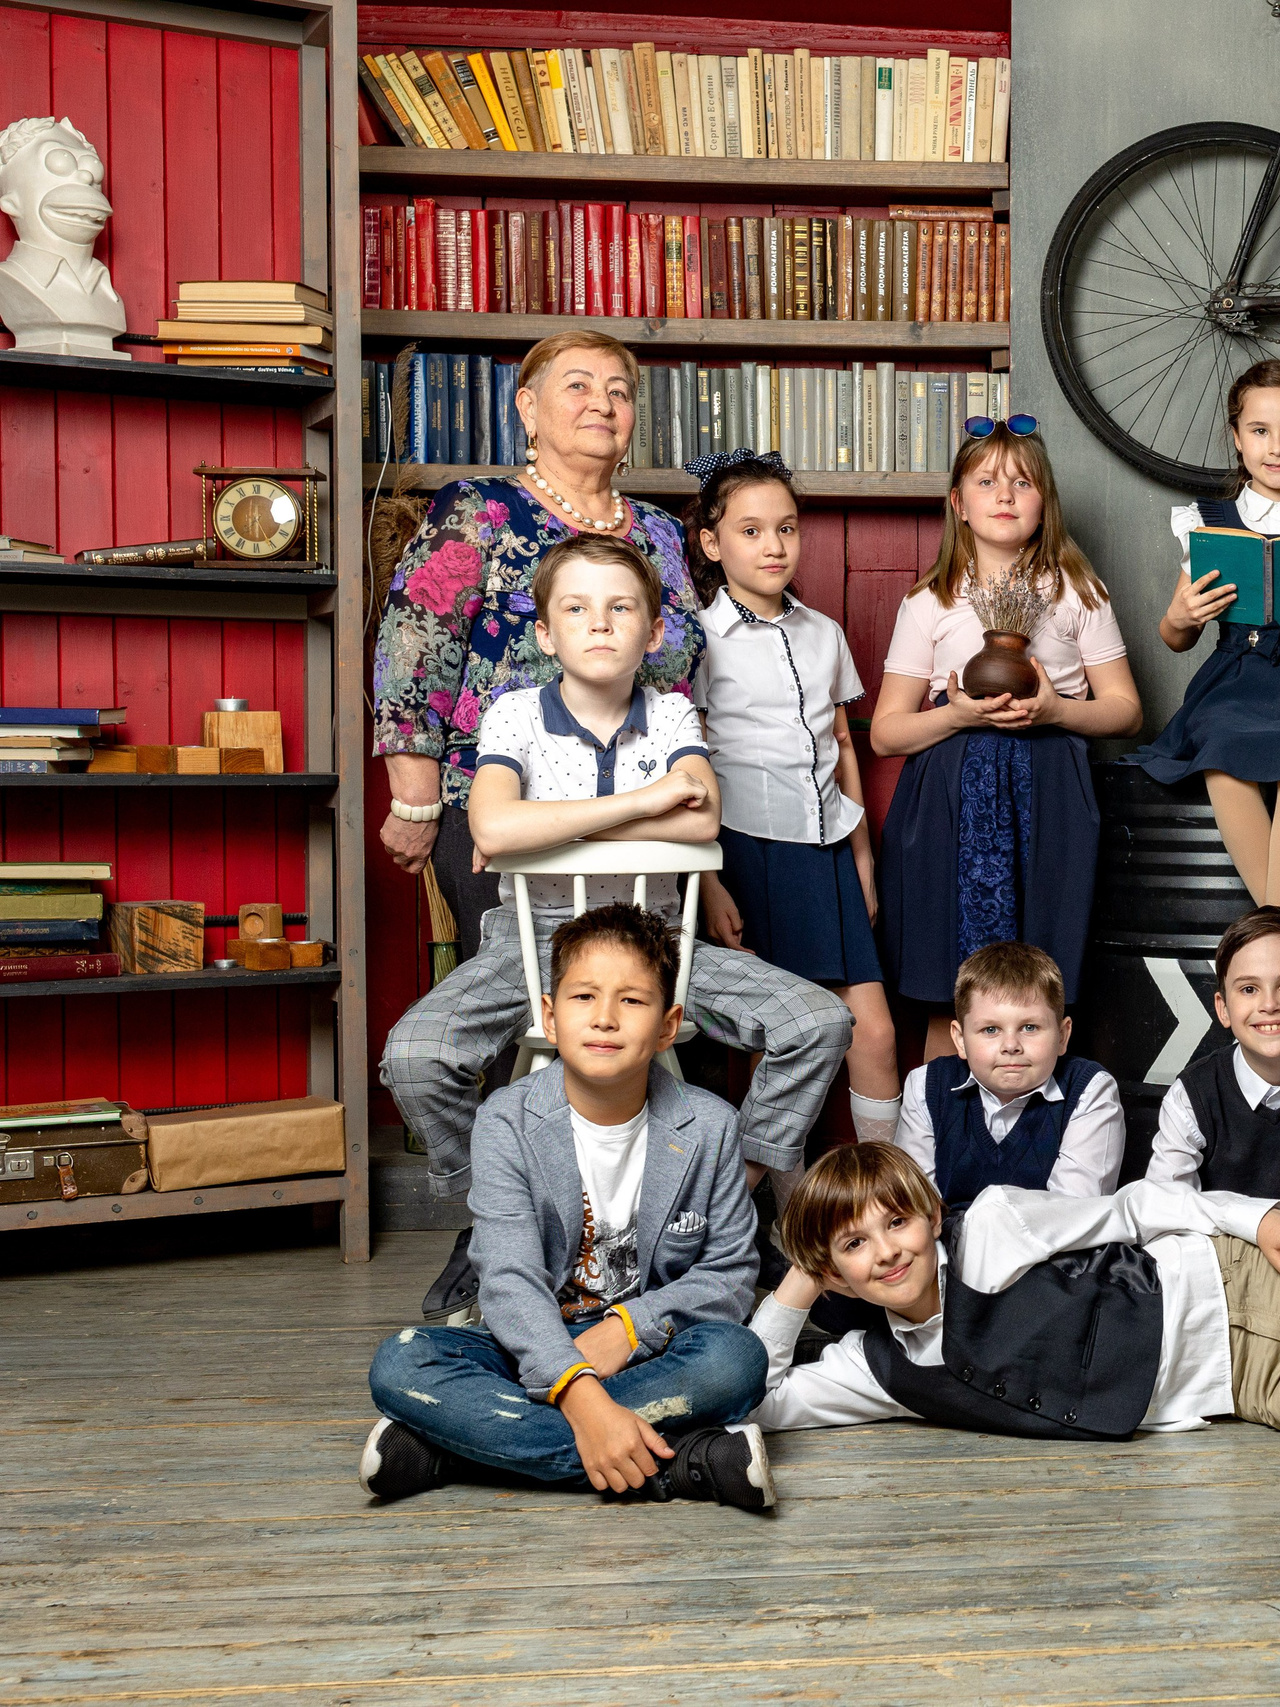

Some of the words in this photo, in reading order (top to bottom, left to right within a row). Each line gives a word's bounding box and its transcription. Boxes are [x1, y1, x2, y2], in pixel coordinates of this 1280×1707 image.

[499, 67, 516, 99] ГРИН
[967, 68, 975, 102] ТУННЕЛЬ
[707, 75, 715, 112] Есенин
[511, 105, 527, 139] ГРЭМ
[681, 107, 689, 127] МАКС
[708, 116, 719, 151] Сергей
[785, 131, 793, 156] БОРИС
[592, 230, 600, 283] ЛЕКАРСТВЕННЫЕ
[628, 235, 639, 279] НАБАТ
[649, 244, 657, 263] ВСЕЙ
[649, 265, 658, 286] ДЕЛО
[496, 290, 501, 299] 2
[878, 304, 885, 312] 4
[903, 303, 908, 311] 5
[638, 374, 646, 398] МИРА
[362, 414, 370, 438] ГОРОДОК
[414, 388, 422, 447] ГРАЖДАНСКОЕ
[639, 403, 647, 448] ОТКРЫТИЕ
[457, 450, 463, 458] 3
[236, 487, 246, 498] XI
[252, 484, 261, 494] XII
[269, 489, 275, 498] I
[224, 499, 235, 508] X
[223, 527, 236, 539] VIII
[278, 529, 289, 539] IV
[235, 538, 246, 550] VII
[253, 543, 260, 553] VI
[76, 960, 87, 973] 24
